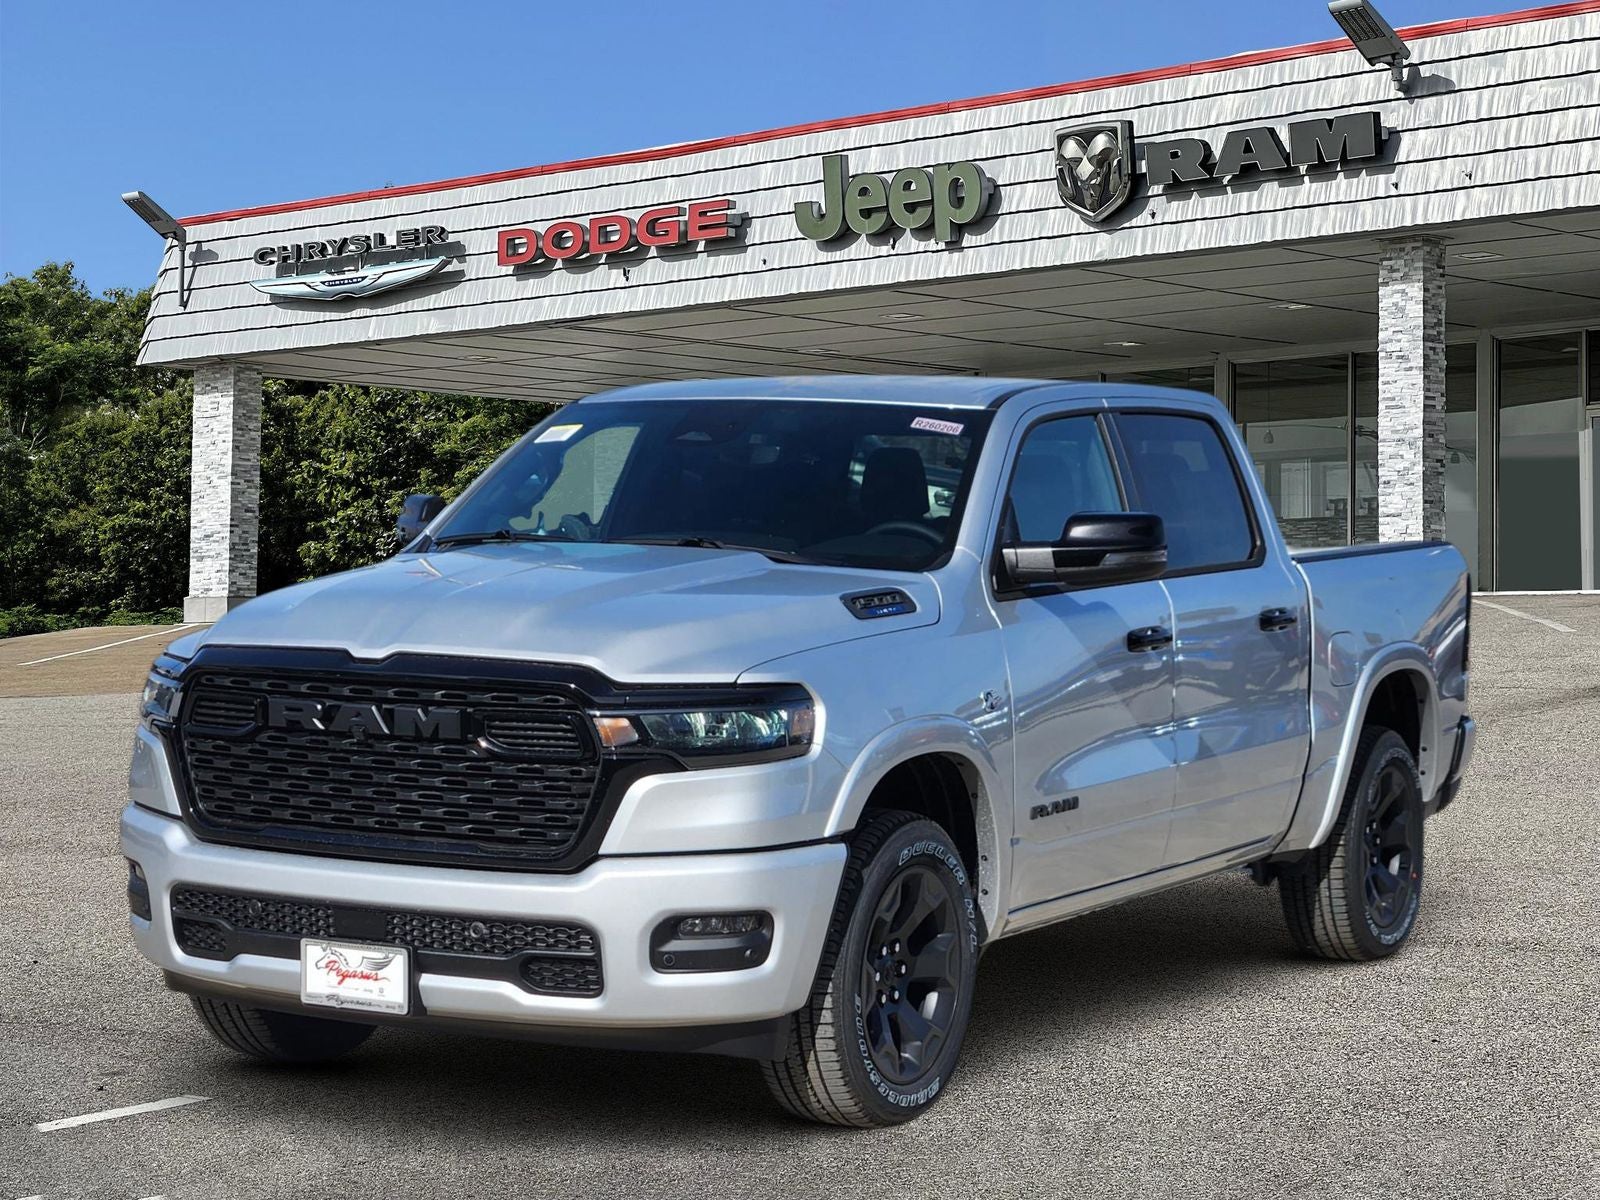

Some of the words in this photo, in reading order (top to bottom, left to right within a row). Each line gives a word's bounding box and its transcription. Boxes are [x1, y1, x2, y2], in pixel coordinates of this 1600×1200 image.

[1145, 112, 1381, 187] RAM
[794, 154, 995, 243] Jeep
[253, 225, 449, 266] CHRYSLER
[498, 199, 736, 267] DODGE
[324, 277, 363, 286] CHRYSLER
[268, 696, 463, 740] RAM
[1029, 796, 1080, 820] RAM
[325, 960, 380, 986] Pegasus
